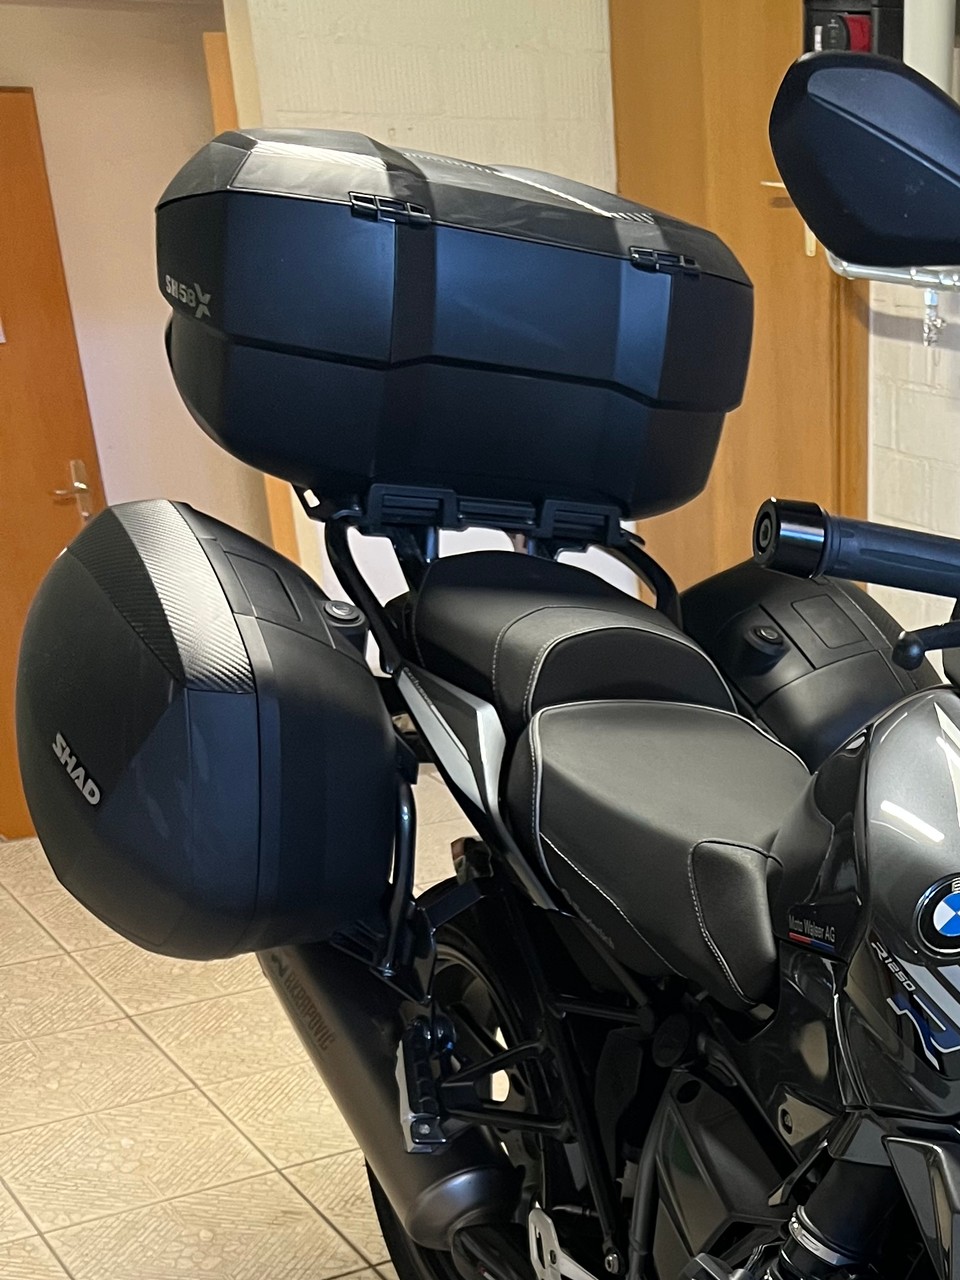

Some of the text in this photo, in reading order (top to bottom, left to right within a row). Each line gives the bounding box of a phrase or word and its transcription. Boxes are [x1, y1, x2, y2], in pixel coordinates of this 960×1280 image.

[166, 274, 211, 318] SH58X
[52, 732, 100, 805] SHAD
[825, 926, 835, 942] AG
